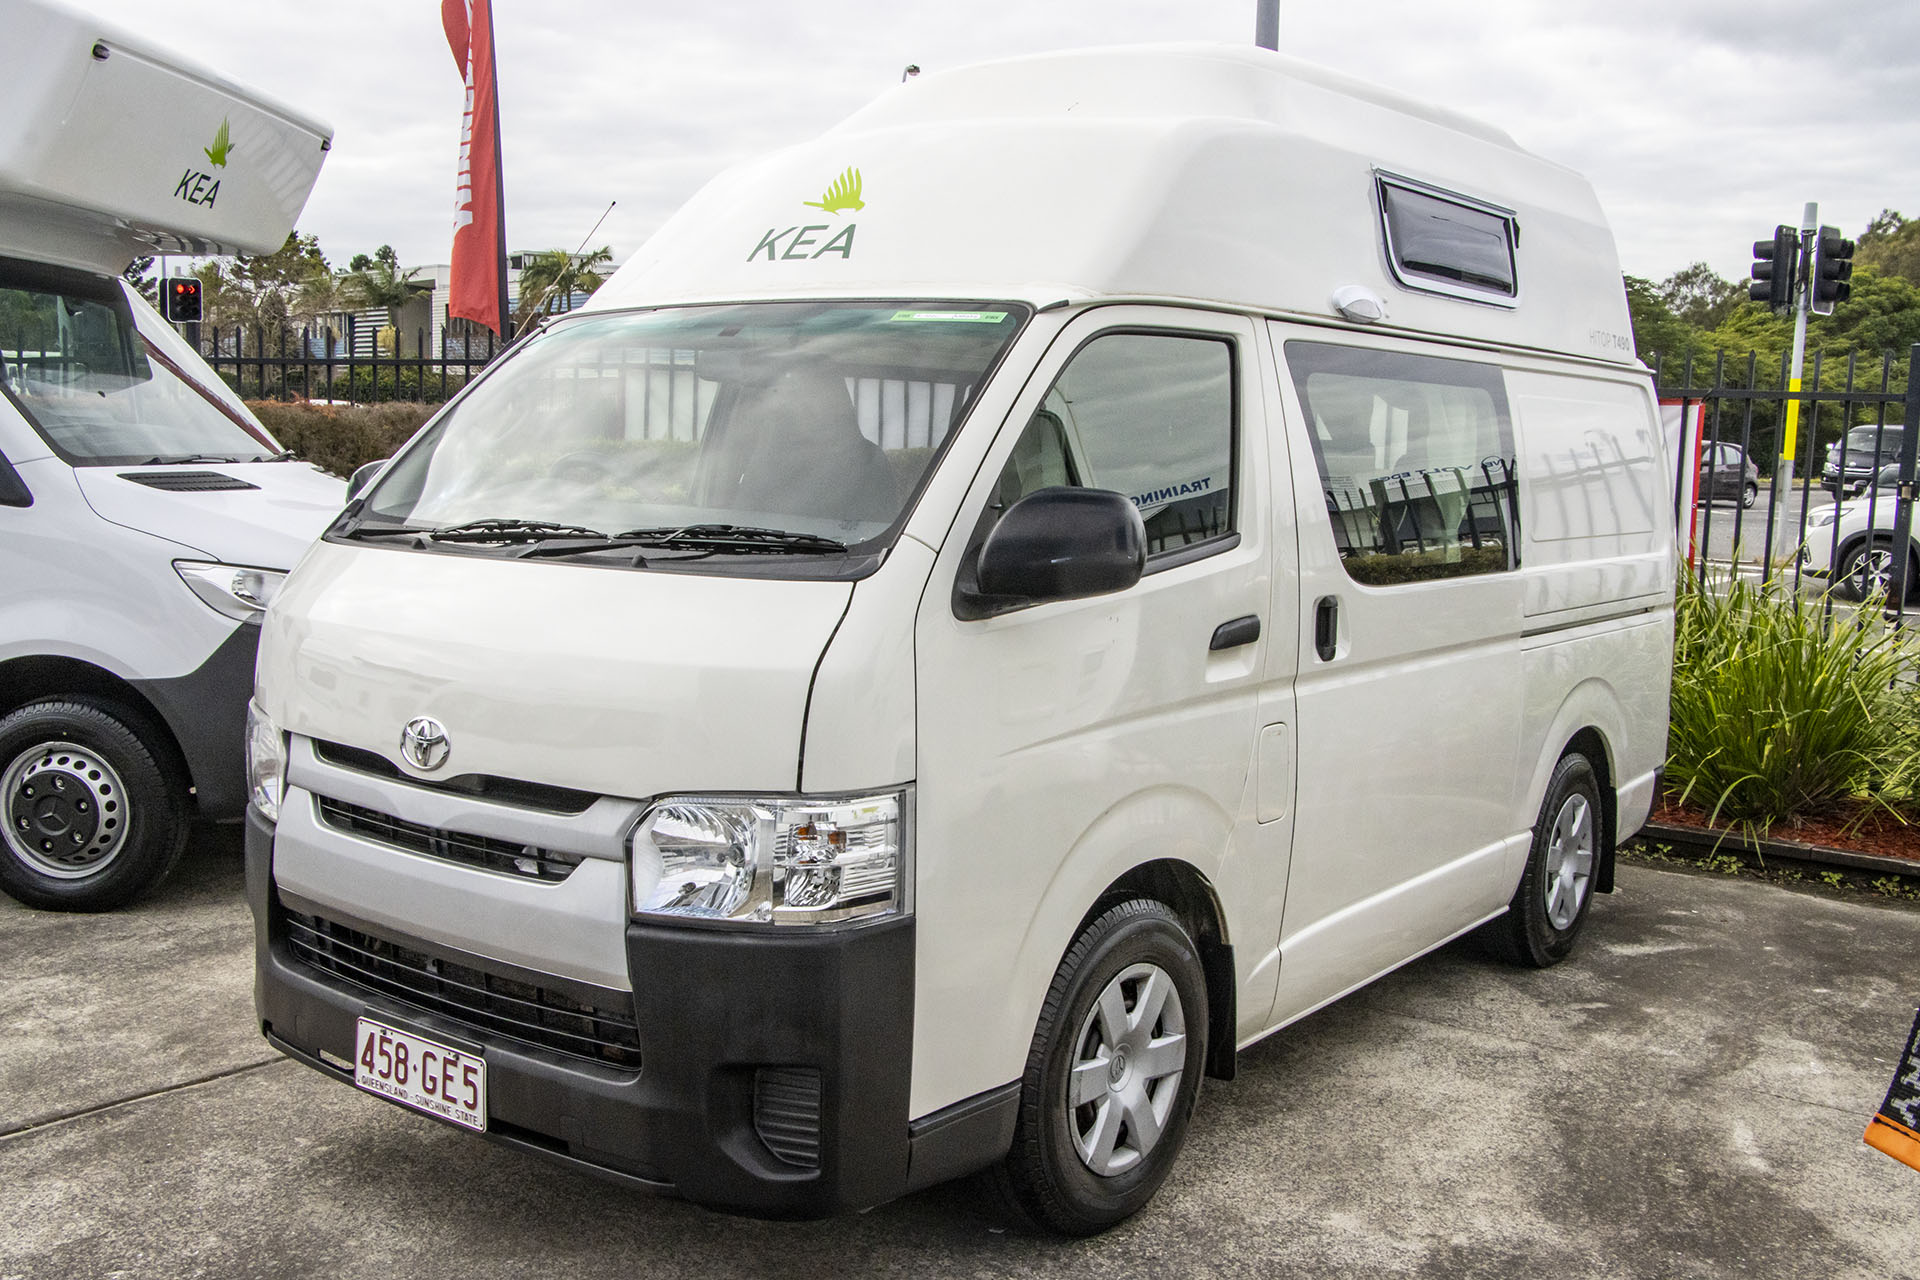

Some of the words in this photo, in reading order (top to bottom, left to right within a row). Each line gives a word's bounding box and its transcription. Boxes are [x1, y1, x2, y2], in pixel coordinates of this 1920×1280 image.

[174, 168, 221, 209] KEA
[746, 223, 857, 262] KEA
[361, 1075, 408, 1099] QUEENSLAND
[415, 1094, 451, 1116] SUNSHINE
[455, 1108, 478, 1127] STATE
